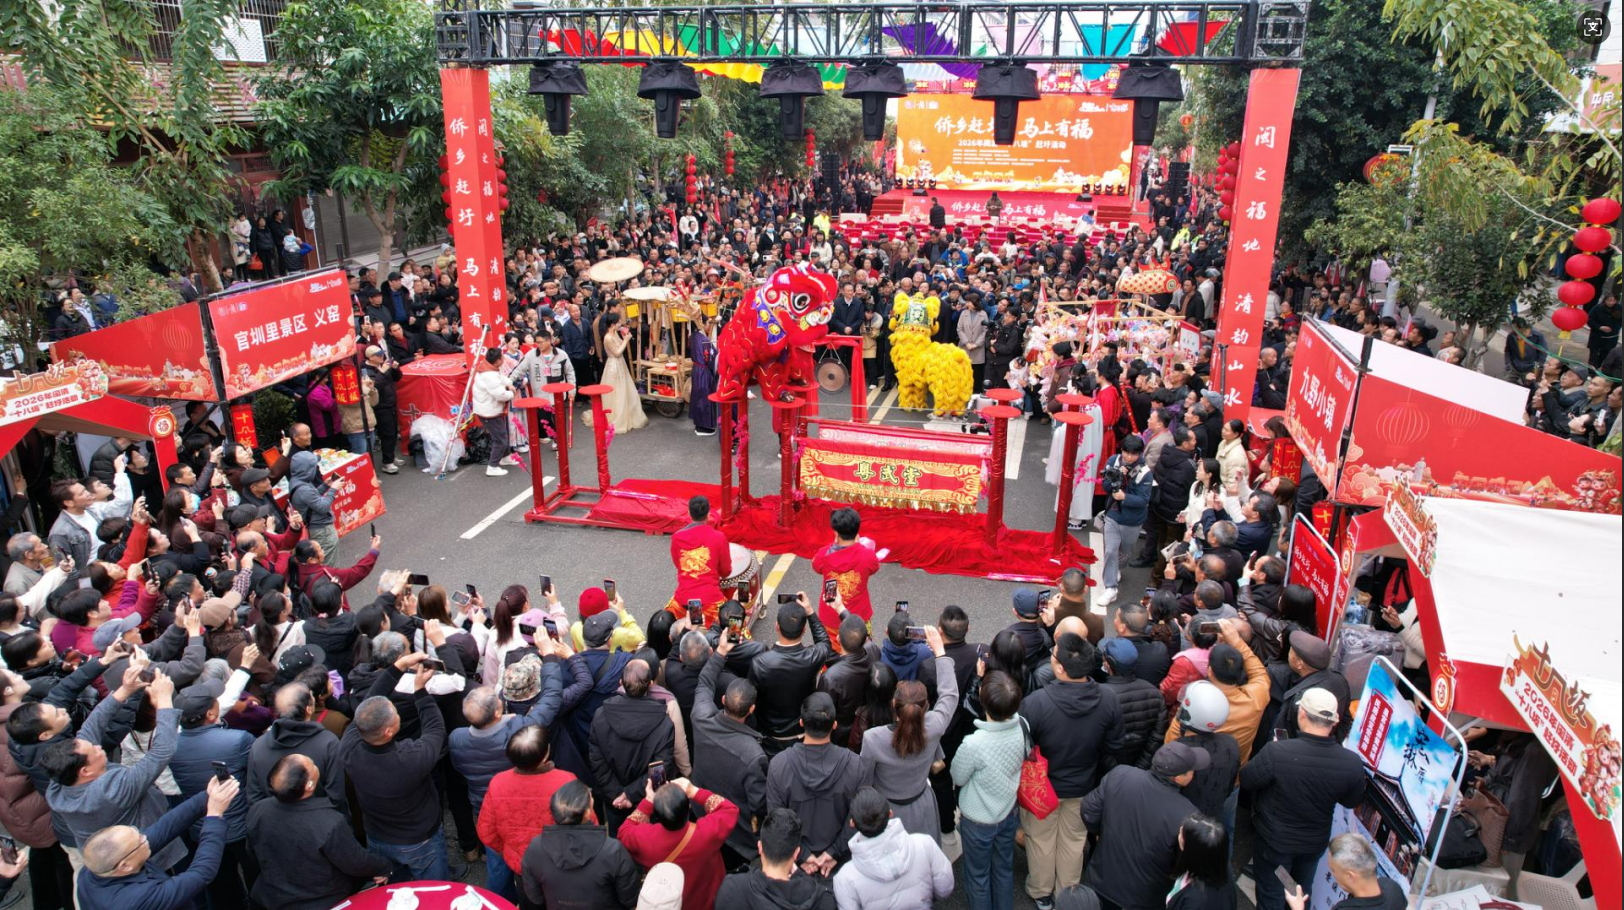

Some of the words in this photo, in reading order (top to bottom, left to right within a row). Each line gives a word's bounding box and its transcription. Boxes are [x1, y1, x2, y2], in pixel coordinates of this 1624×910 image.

[478, 118, 495, 224] 闽之福地
[1018, 116, 1094, 140] 马上有福
[1242, 126, 1276, 253] 闽之福地
[449, 117, 475, 226] 侨乡赶圩
[462, 257, 488, 355] 马上有福
[234, 313, 308, 351] 官圳里景区
[313, 305, 341, 328] 义窑
[1223, 294, 1254, 406] 清韵山水
[1300, 366, 1337, 432] 九野小镇
[1524, 682, 1575, 752] 2026年闽清
